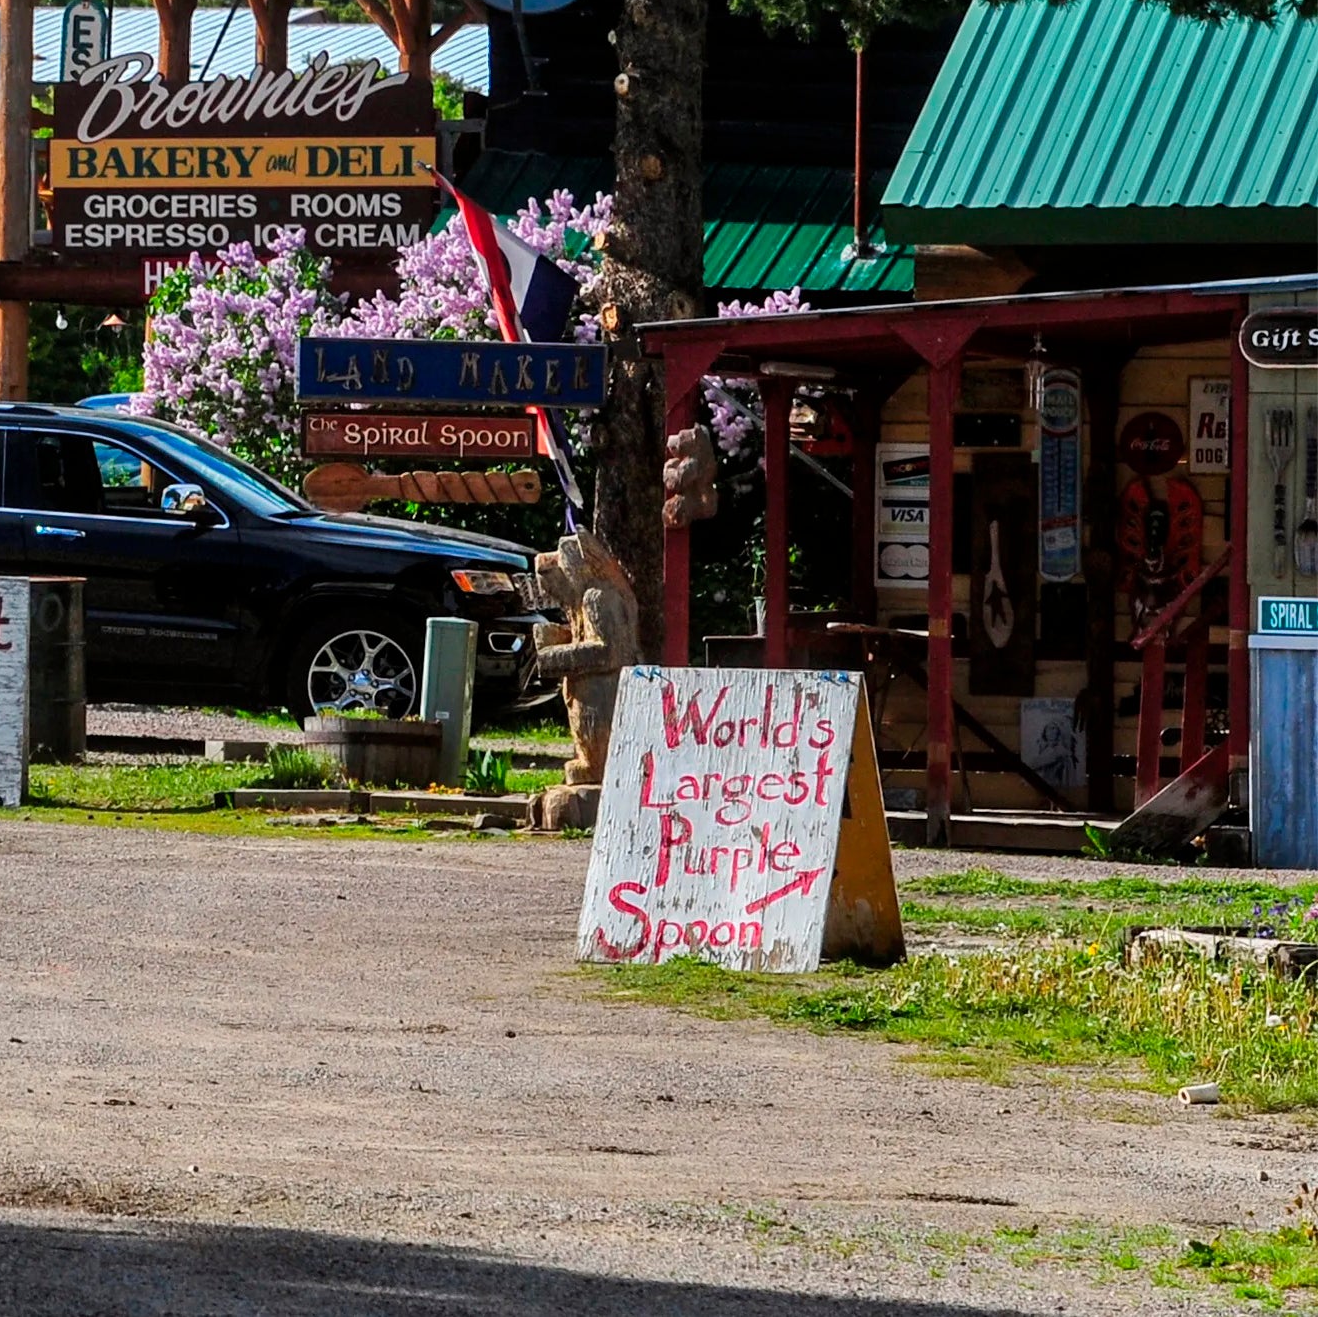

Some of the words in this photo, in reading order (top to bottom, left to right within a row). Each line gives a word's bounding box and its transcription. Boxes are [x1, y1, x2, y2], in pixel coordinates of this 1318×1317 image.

[76, 49, 411, 143] Brownies
[65, 145, 263, 179] BAKERY
[266, 147, 298, 174] and
[305, 144, 417, 177] DELI
[83, 193, 258, 219] GROCERIES
[290, 193, 402, 218] ROOMS
[65, 222, 229, 248] ESPRESSO
[315, 222, 420, 248] CREAM
[1251, 328, 1302, 352] Gift
[308, 416, 339, 432] The
[343, 420, 430, 456] Spiral
[439, 424, 530, 459] Spoon
[891, 508, 924, 522] VISA
[1269, 602, 1313, 629] SPIRAL
[662, 681, 836, 750] World's
[640, 749, 834, 826] Largest
[654, 813, 802, 895] Purple
[597, 881, 764, 963] Spoon
